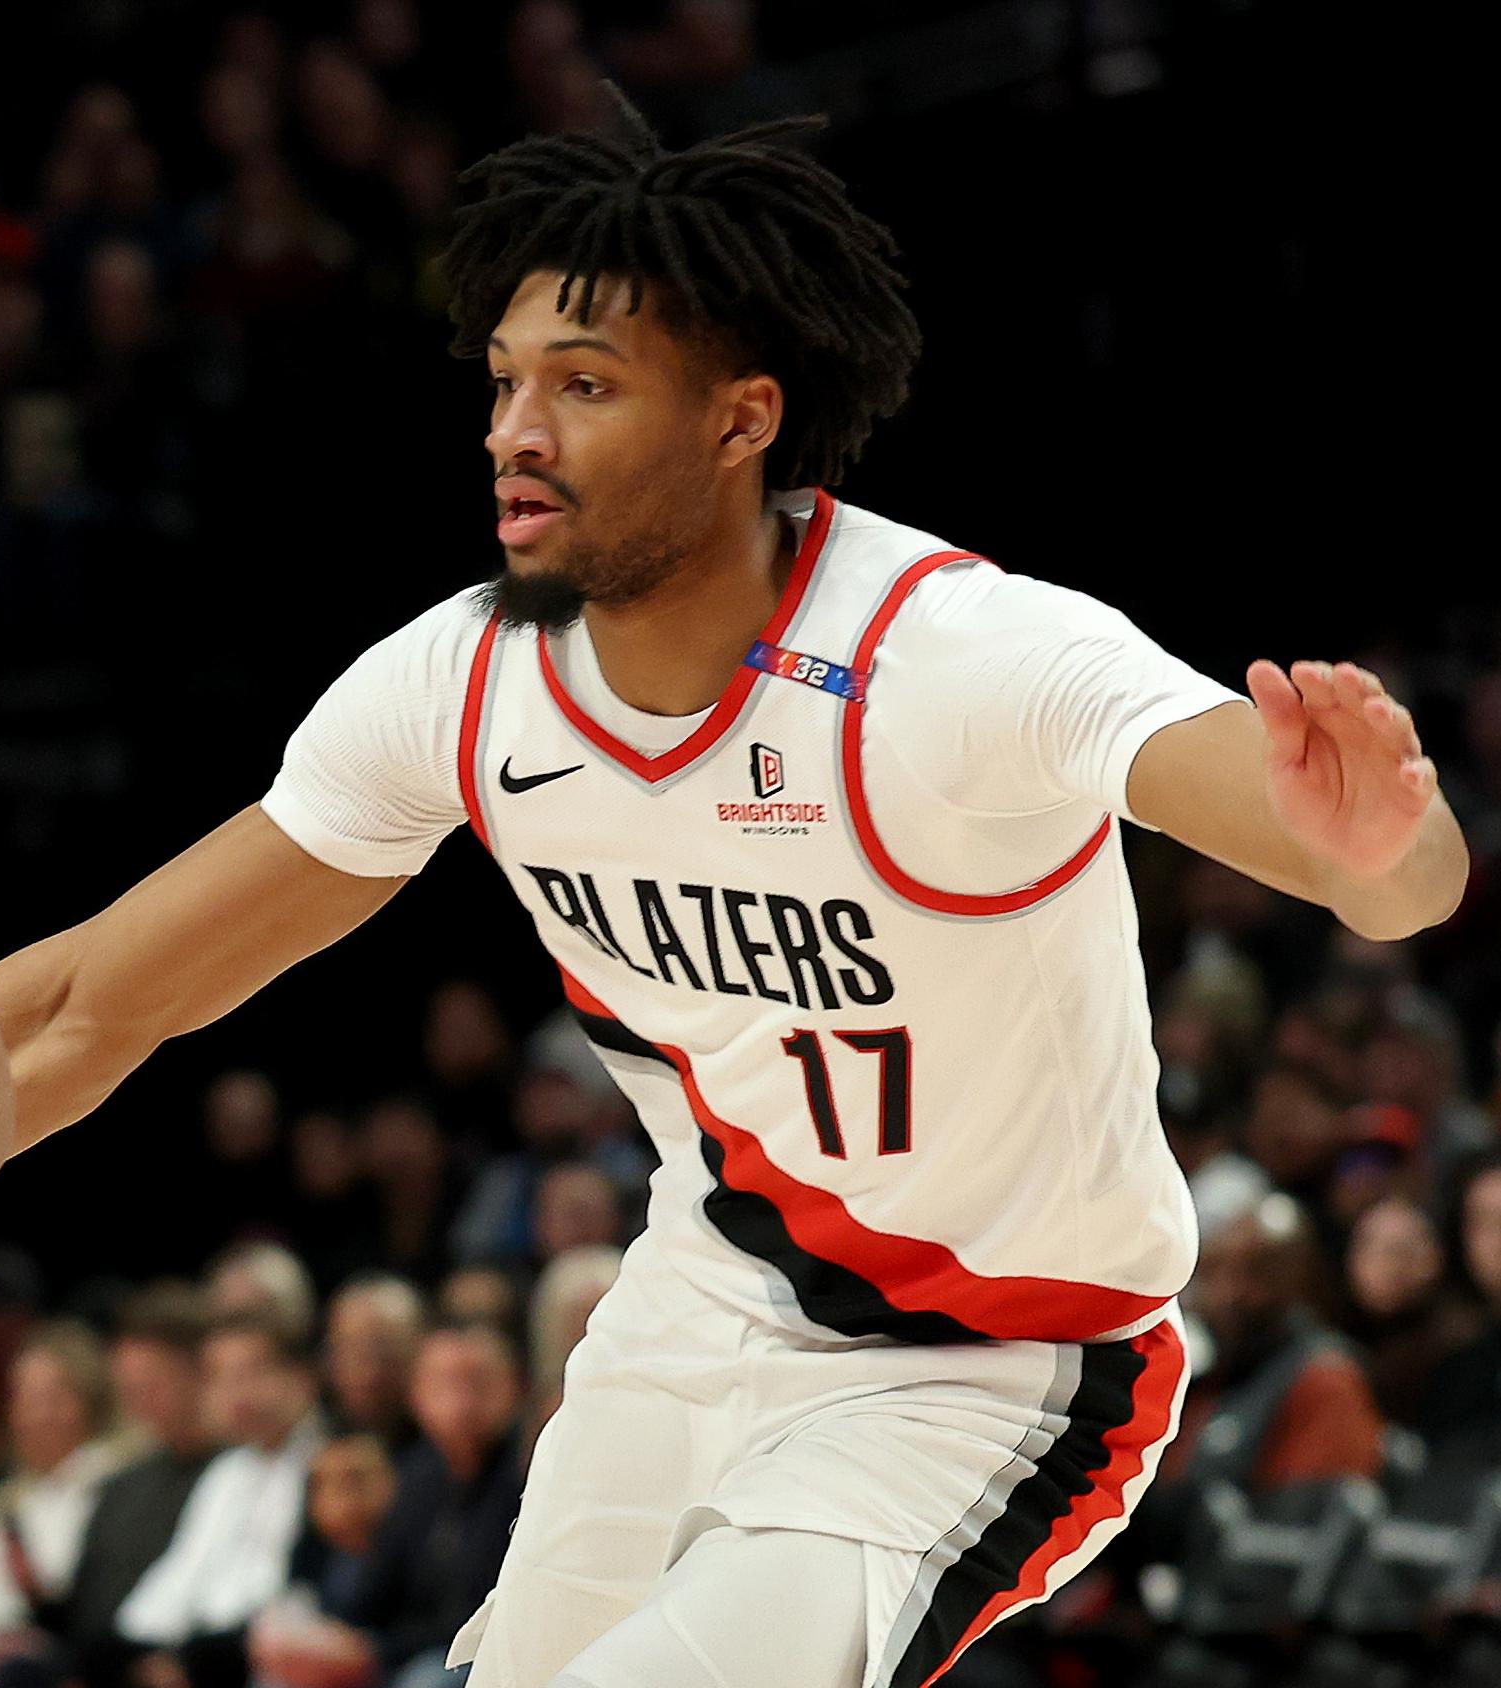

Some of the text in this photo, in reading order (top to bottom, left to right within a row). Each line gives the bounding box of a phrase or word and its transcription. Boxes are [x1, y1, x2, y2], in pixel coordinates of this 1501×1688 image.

[791, 655, 830, 687] 32
[716, 803, 827, 822] BRIGHTSIDE
[741, 826, 810, 836] WINDOWS
[521, 863, 894, 1010] BLAZERS
[780, 1025, 912, 1160] 17
